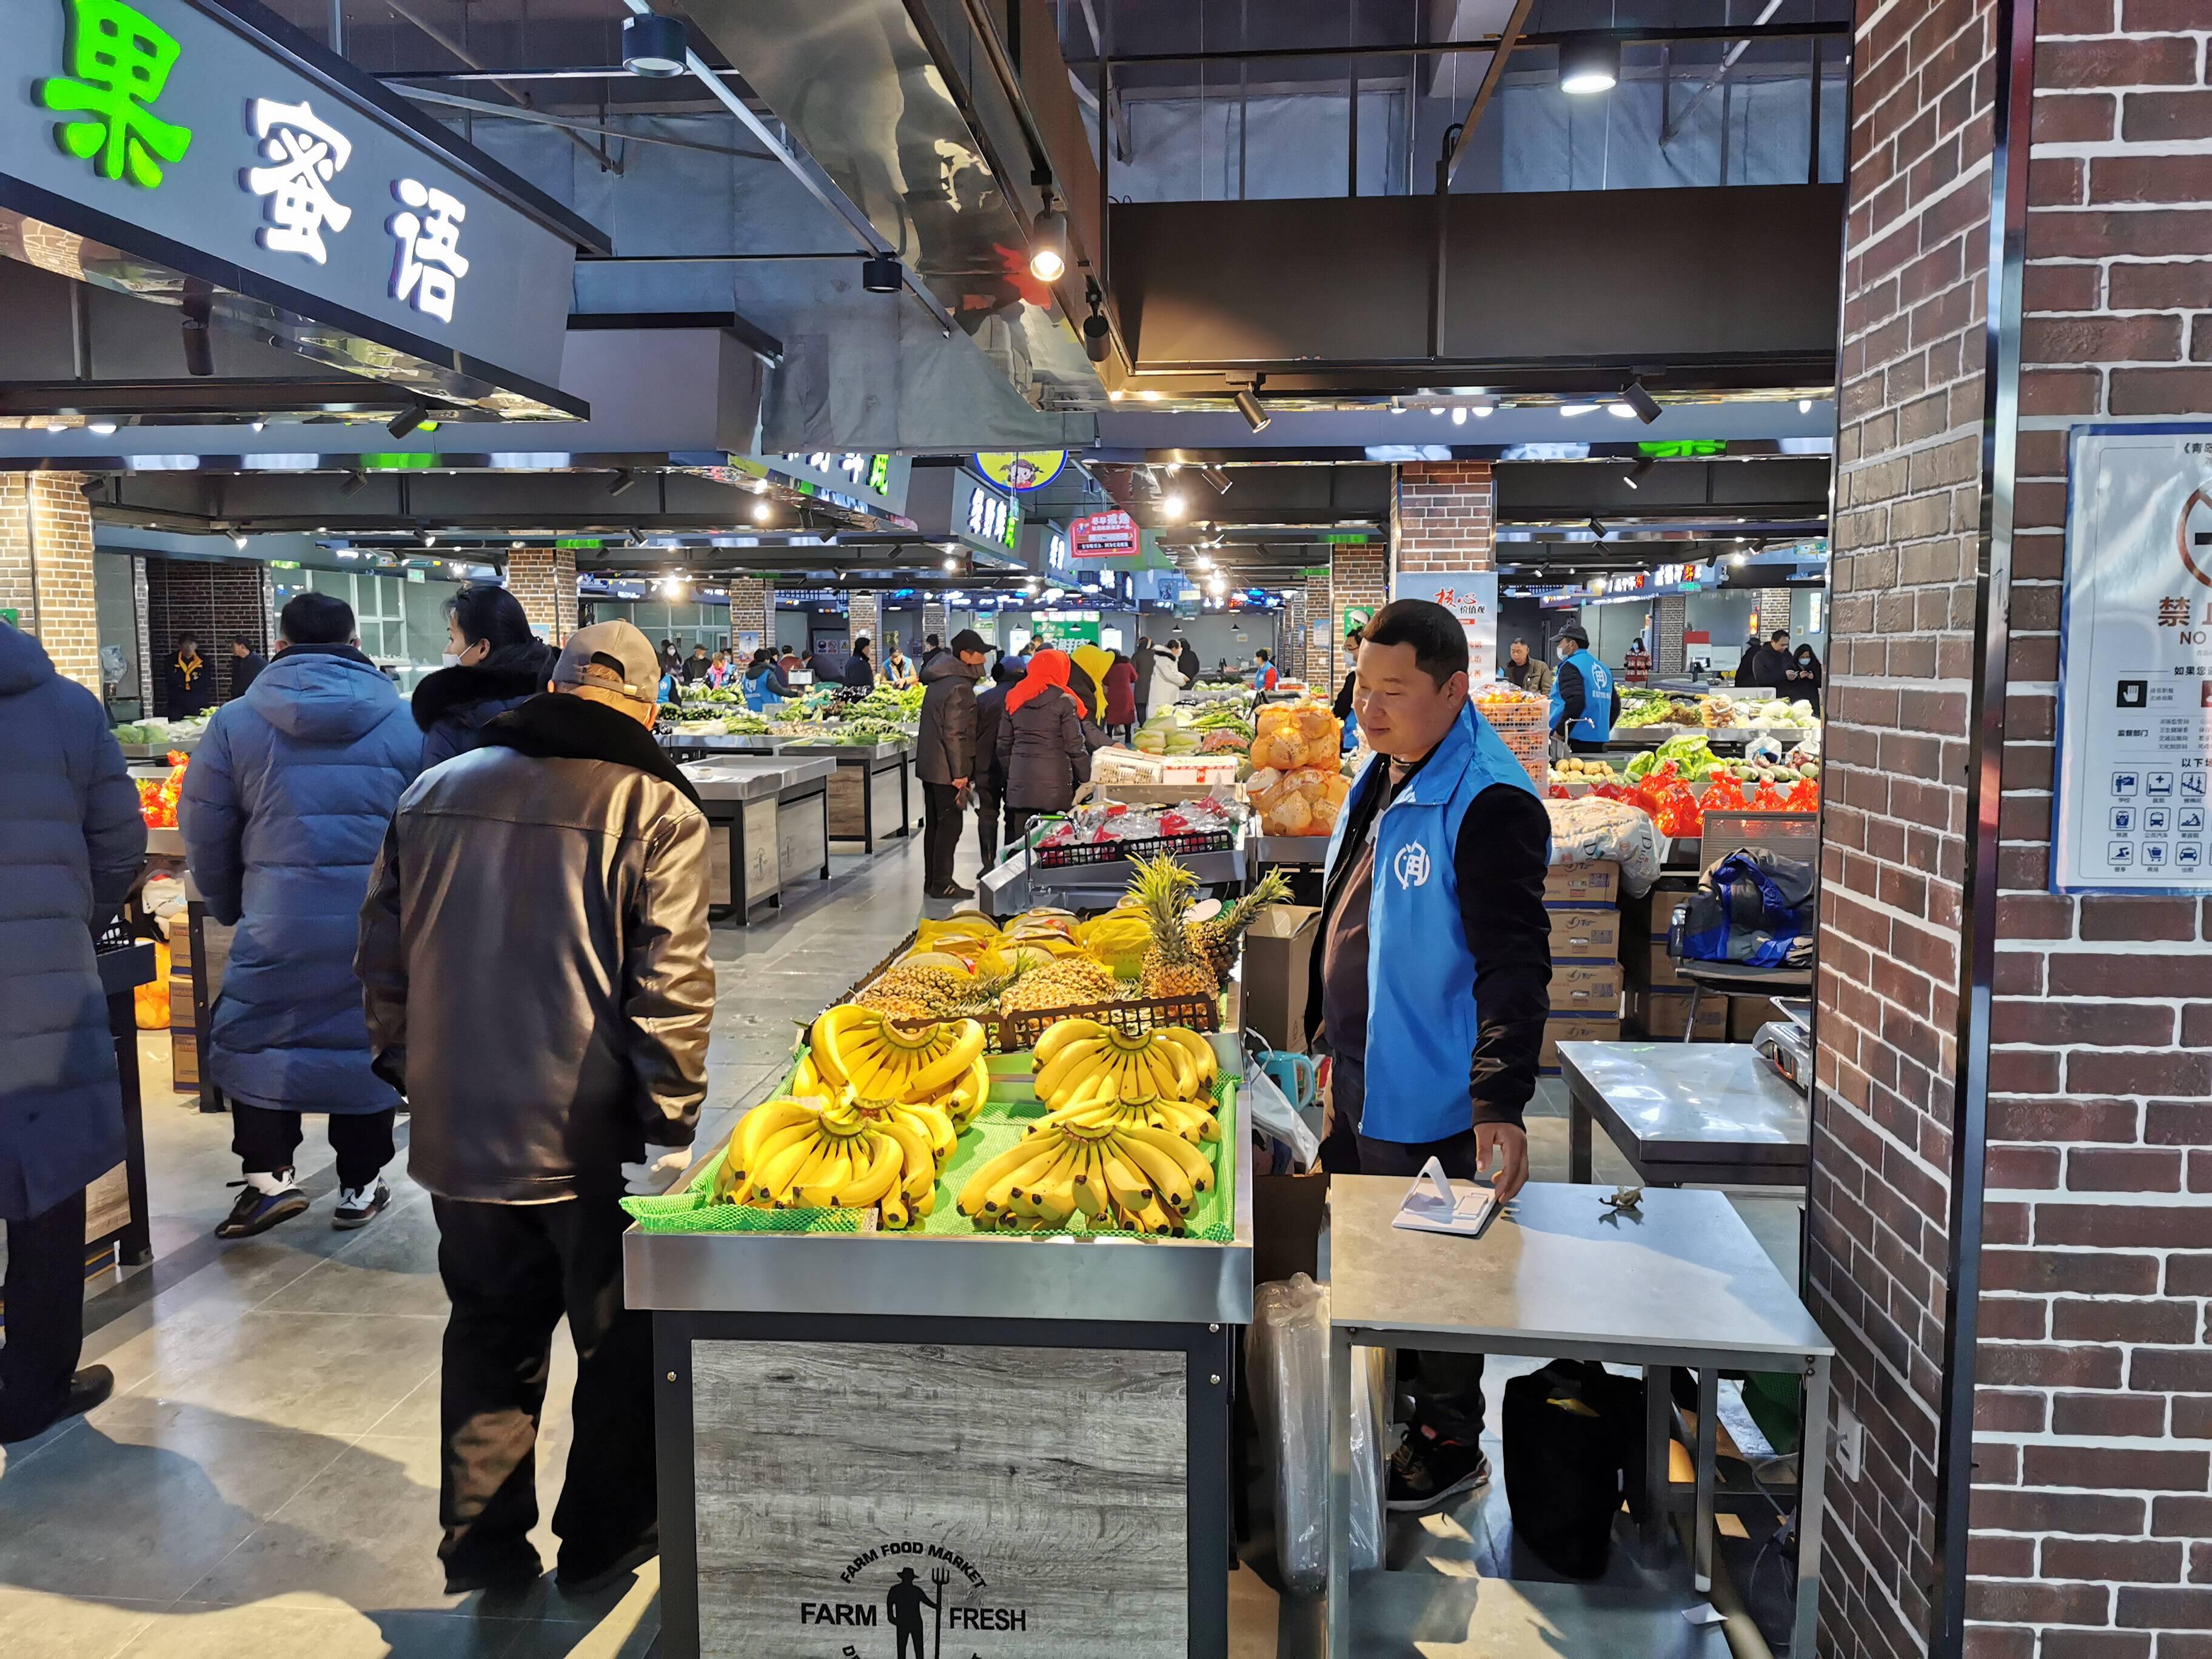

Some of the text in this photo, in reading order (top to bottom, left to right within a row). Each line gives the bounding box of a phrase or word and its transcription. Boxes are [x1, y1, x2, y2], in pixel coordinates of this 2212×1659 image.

[1435, 588, 1477, 607] 核心
[1460, 606, 1485, 614] 价值观
[2180, 631, 2207, 645] NO
[840, 1541, 987, 1589] FARM FOOD MARKET
[801, 1603, 1027, 1631] FARM FRESH
